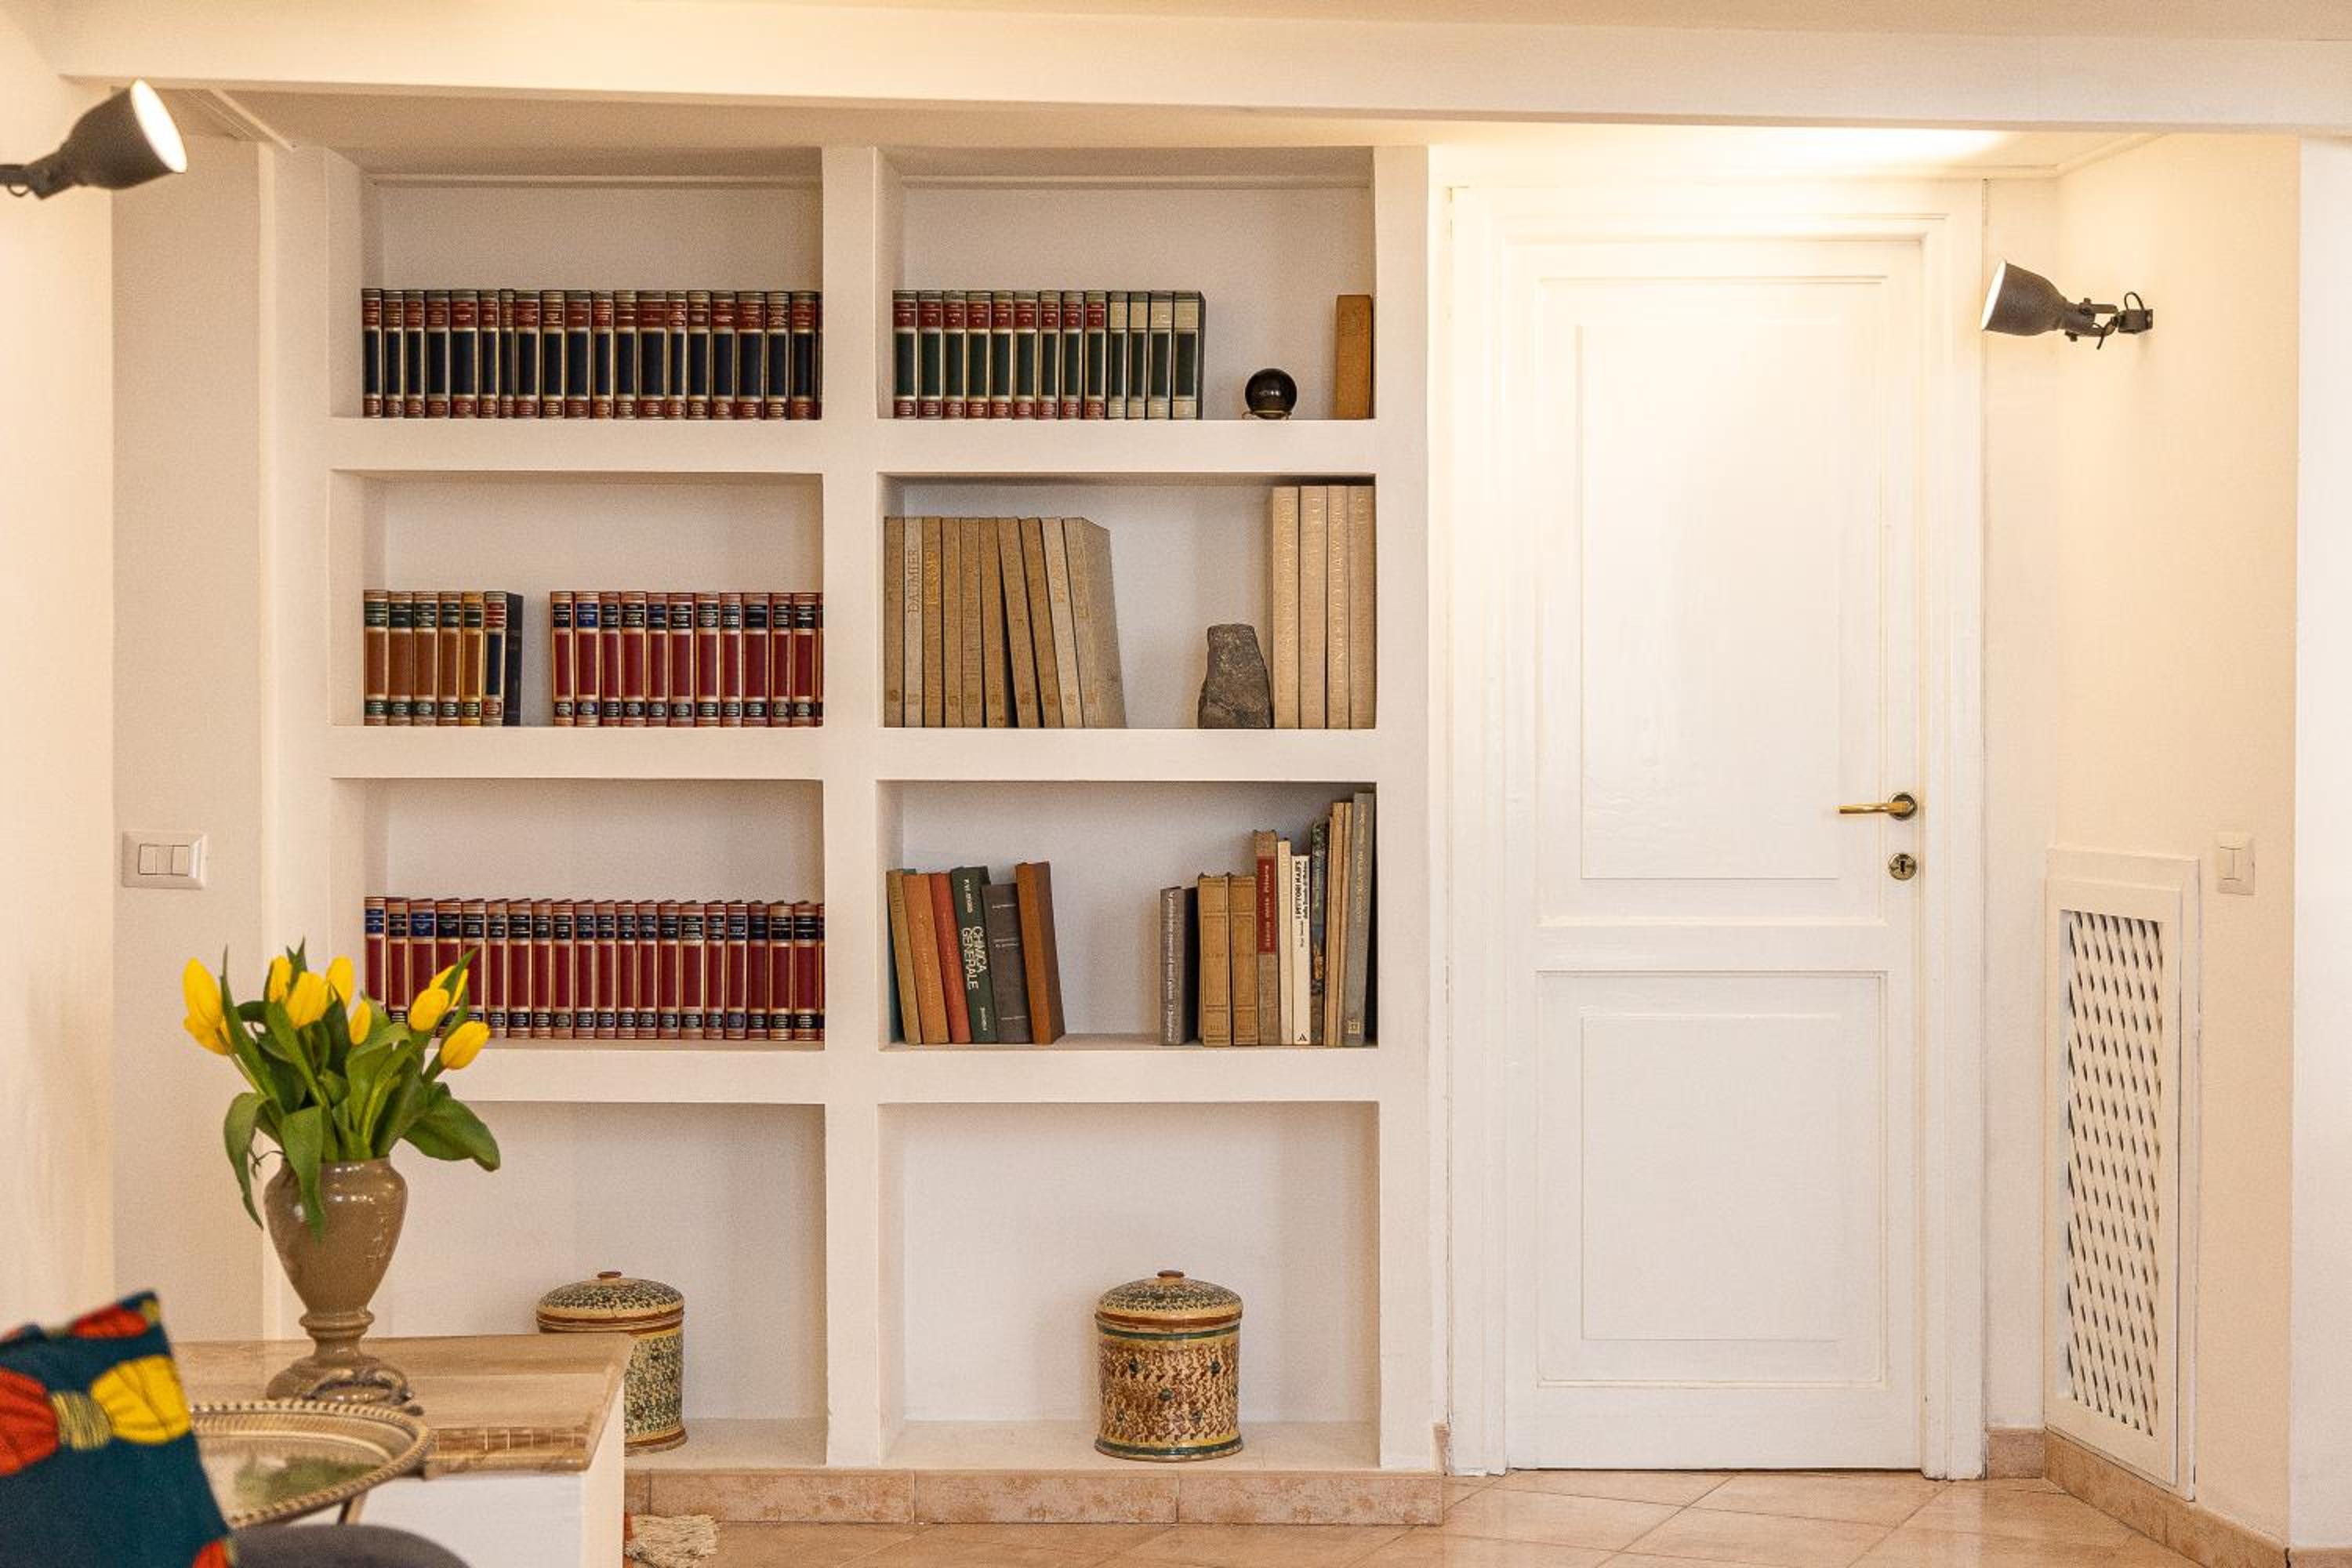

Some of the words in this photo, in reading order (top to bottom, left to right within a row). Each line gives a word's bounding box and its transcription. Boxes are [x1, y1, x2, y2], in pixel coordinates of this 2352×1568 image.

[907, 550, 919, 613] DAUMIER
[962, 927, 979, 991] GENERALE
[971, 926, 988, 974] CHIMICA
